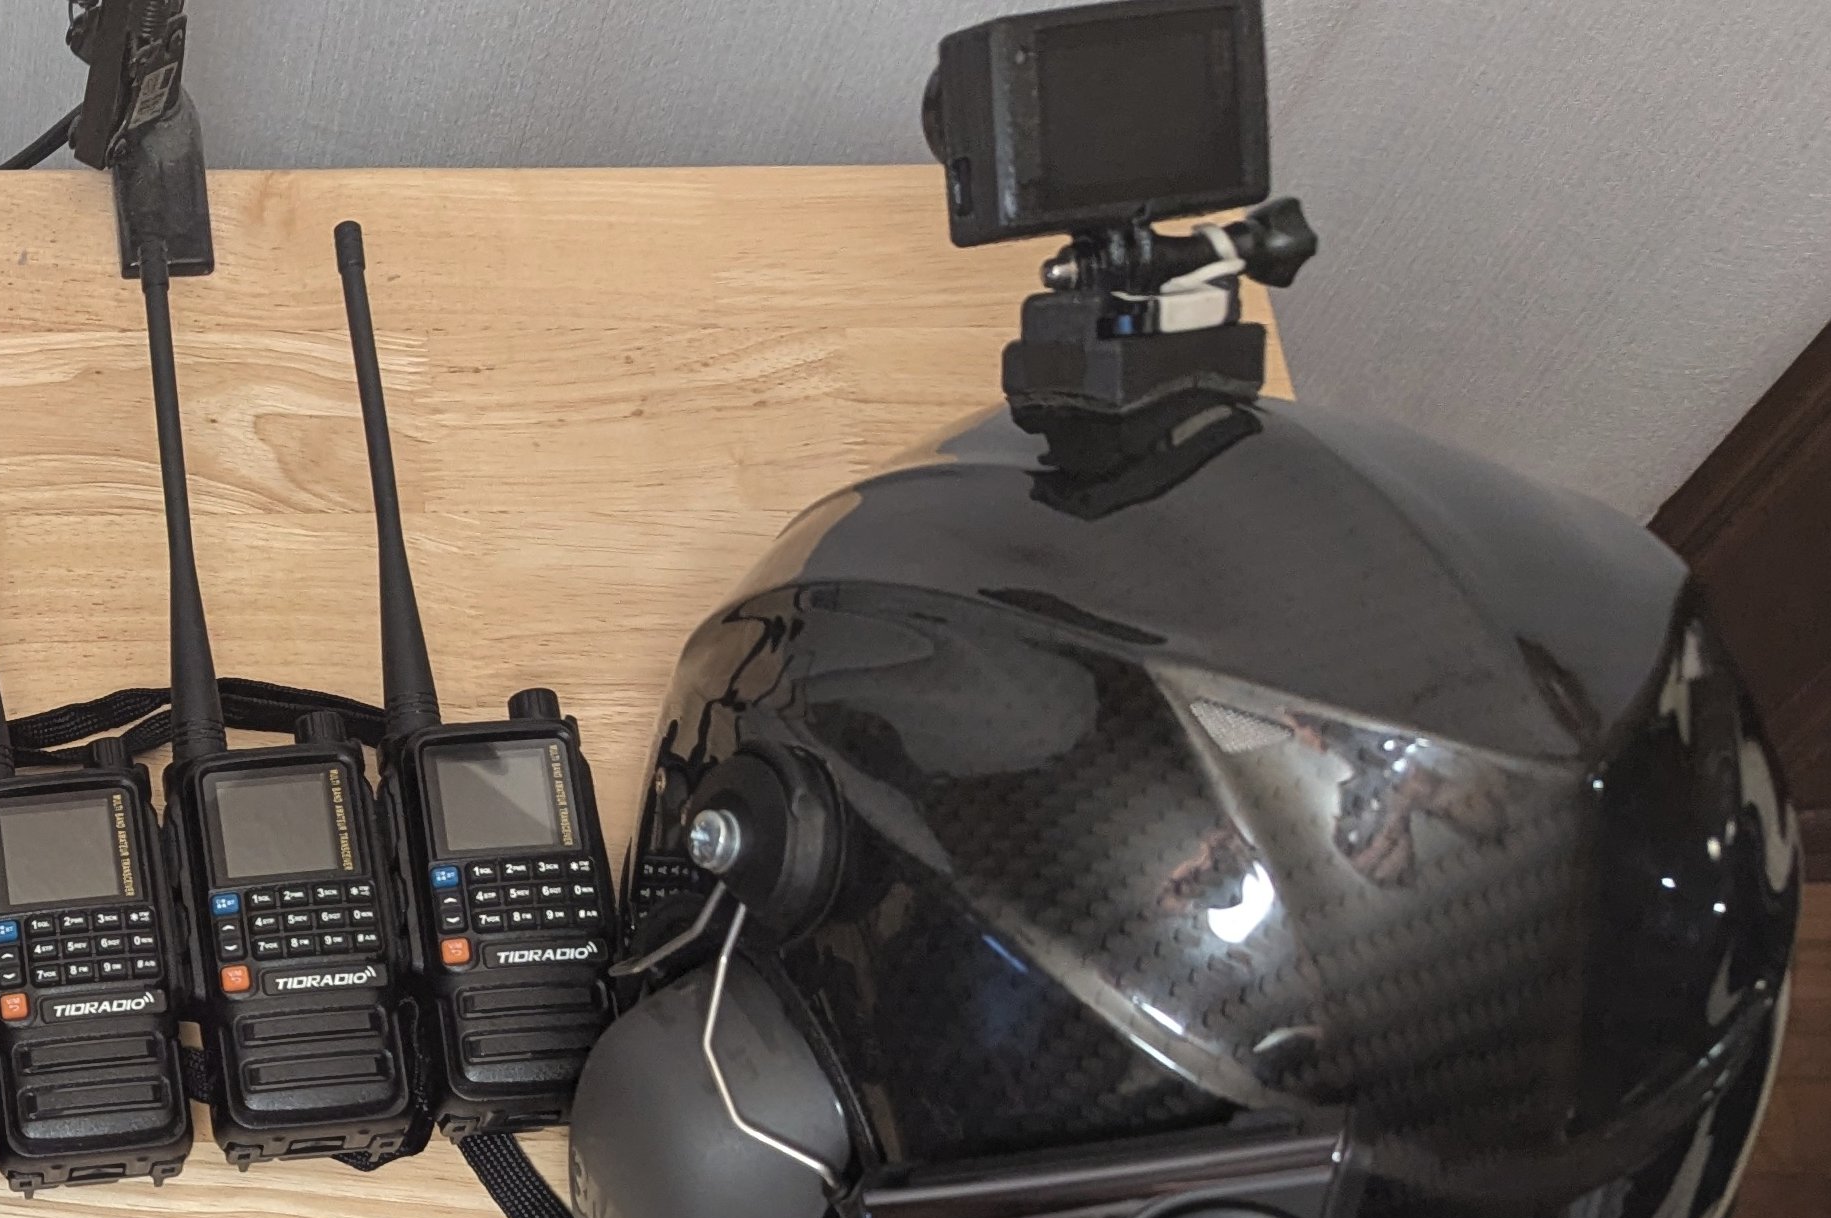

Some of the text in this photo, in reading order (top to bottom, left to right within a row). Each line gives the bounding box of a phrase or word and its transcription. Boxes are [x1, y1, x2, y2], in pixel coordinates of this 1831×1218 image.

[497, 947, 589, 964] TIDRADIO
[275, 972, 367, 990] TIDRADIO
[53, 994, 145, 1017] TIDRADIO
